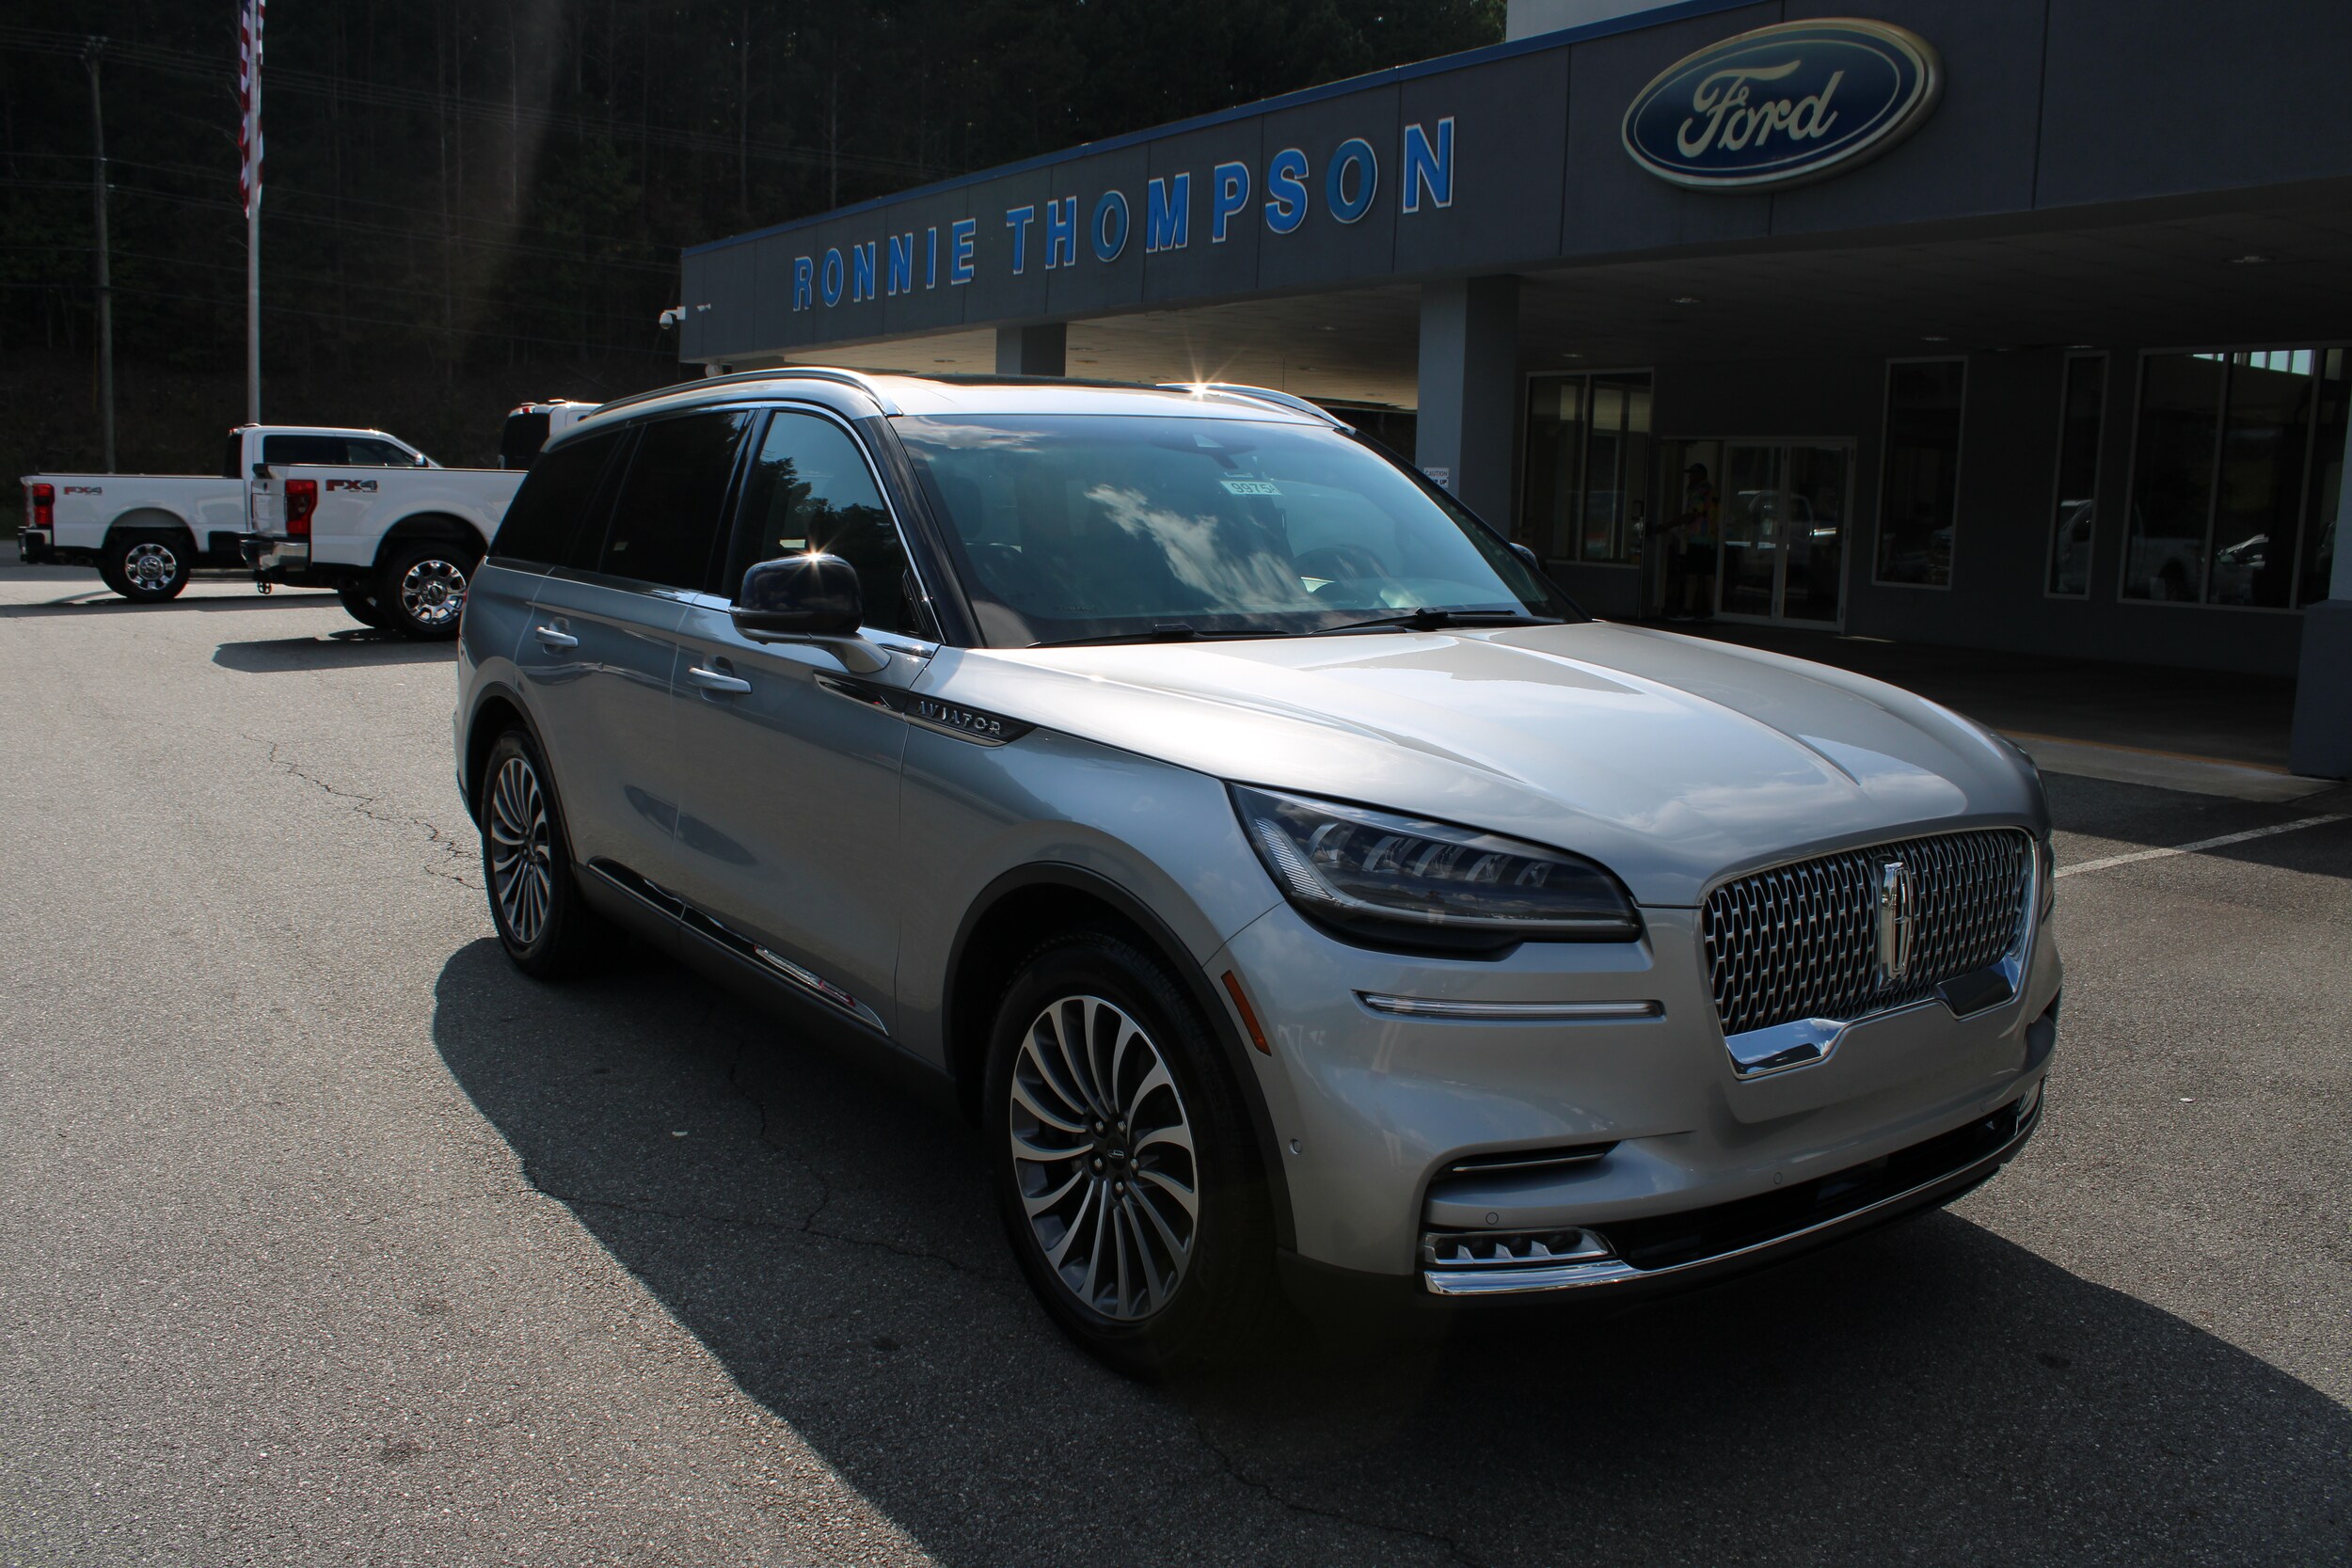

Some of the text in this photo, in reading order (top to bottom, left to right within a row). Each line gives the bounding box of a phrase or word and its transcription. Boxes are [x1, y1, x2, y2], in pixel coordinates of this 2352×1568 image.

[1677, 59, 1845, 159] Ford
[793, 116, 1455, 312] RONNIE THOMPSON
[64, 486, 103, 495] FX4
[326, 479, 378, 491] FX4
[916, 701, 1001, 736] AVIATOR
